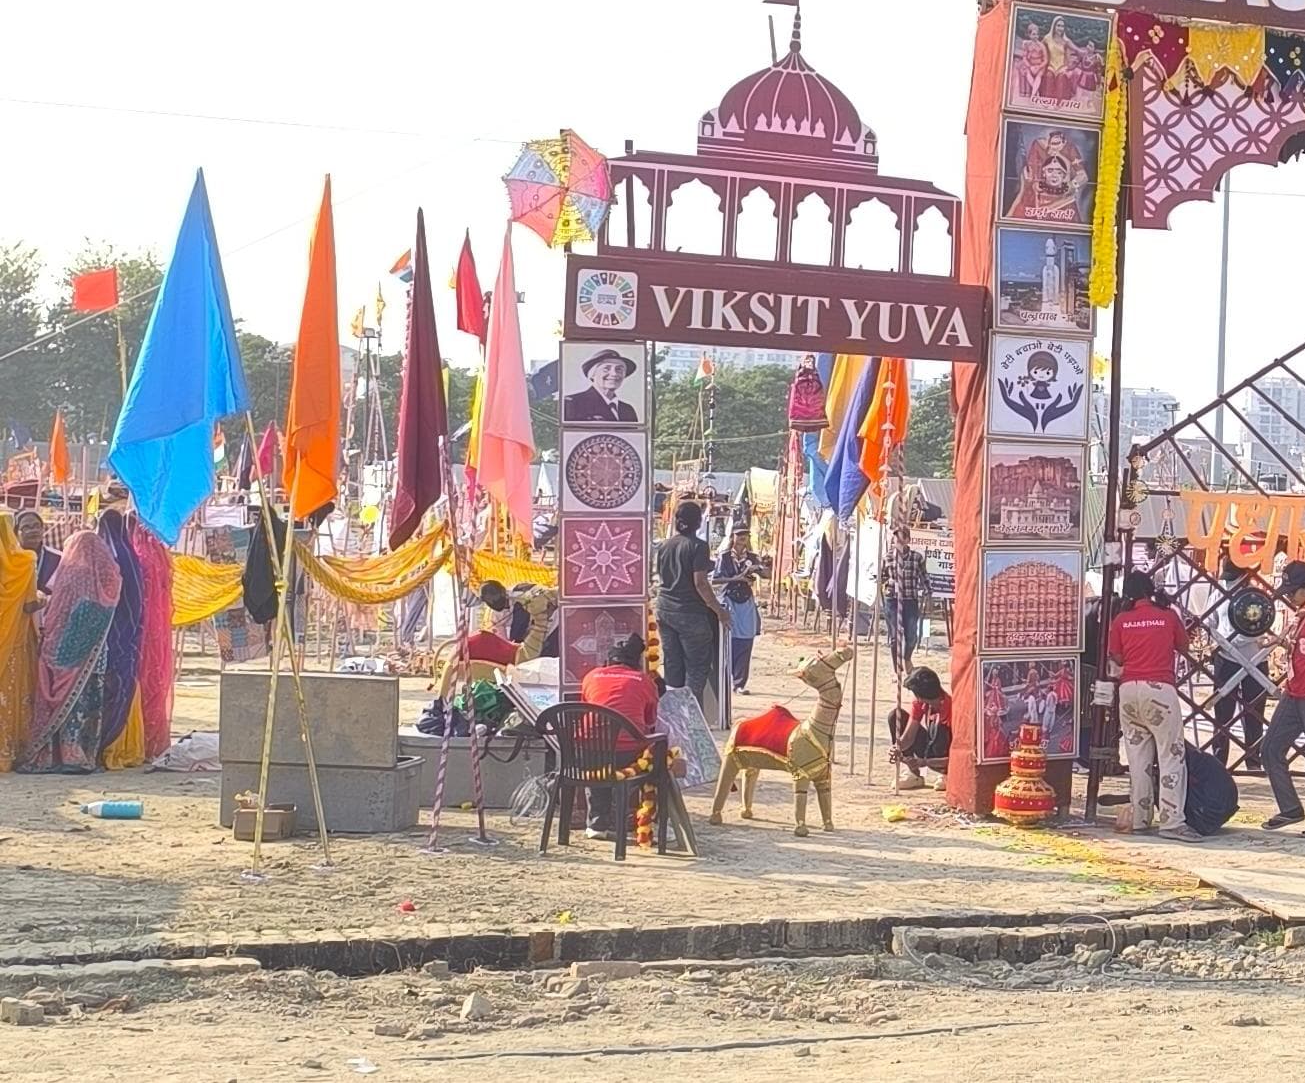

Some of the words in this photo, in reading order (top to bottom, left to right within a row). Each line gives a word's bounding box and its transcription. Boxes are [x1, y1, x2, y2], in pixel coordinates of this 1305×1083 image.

[650, 284, 829, 337] VIKSIT
[839, 297, 973, 348] YUVA
[1000, 353, 1015, 370] बेटी
[1015, 340, 1042, 356] बचाओ
[1047, 341, 1063, 354] बेटी
[1122, 619, 1165, 629] RAJASTHAN
